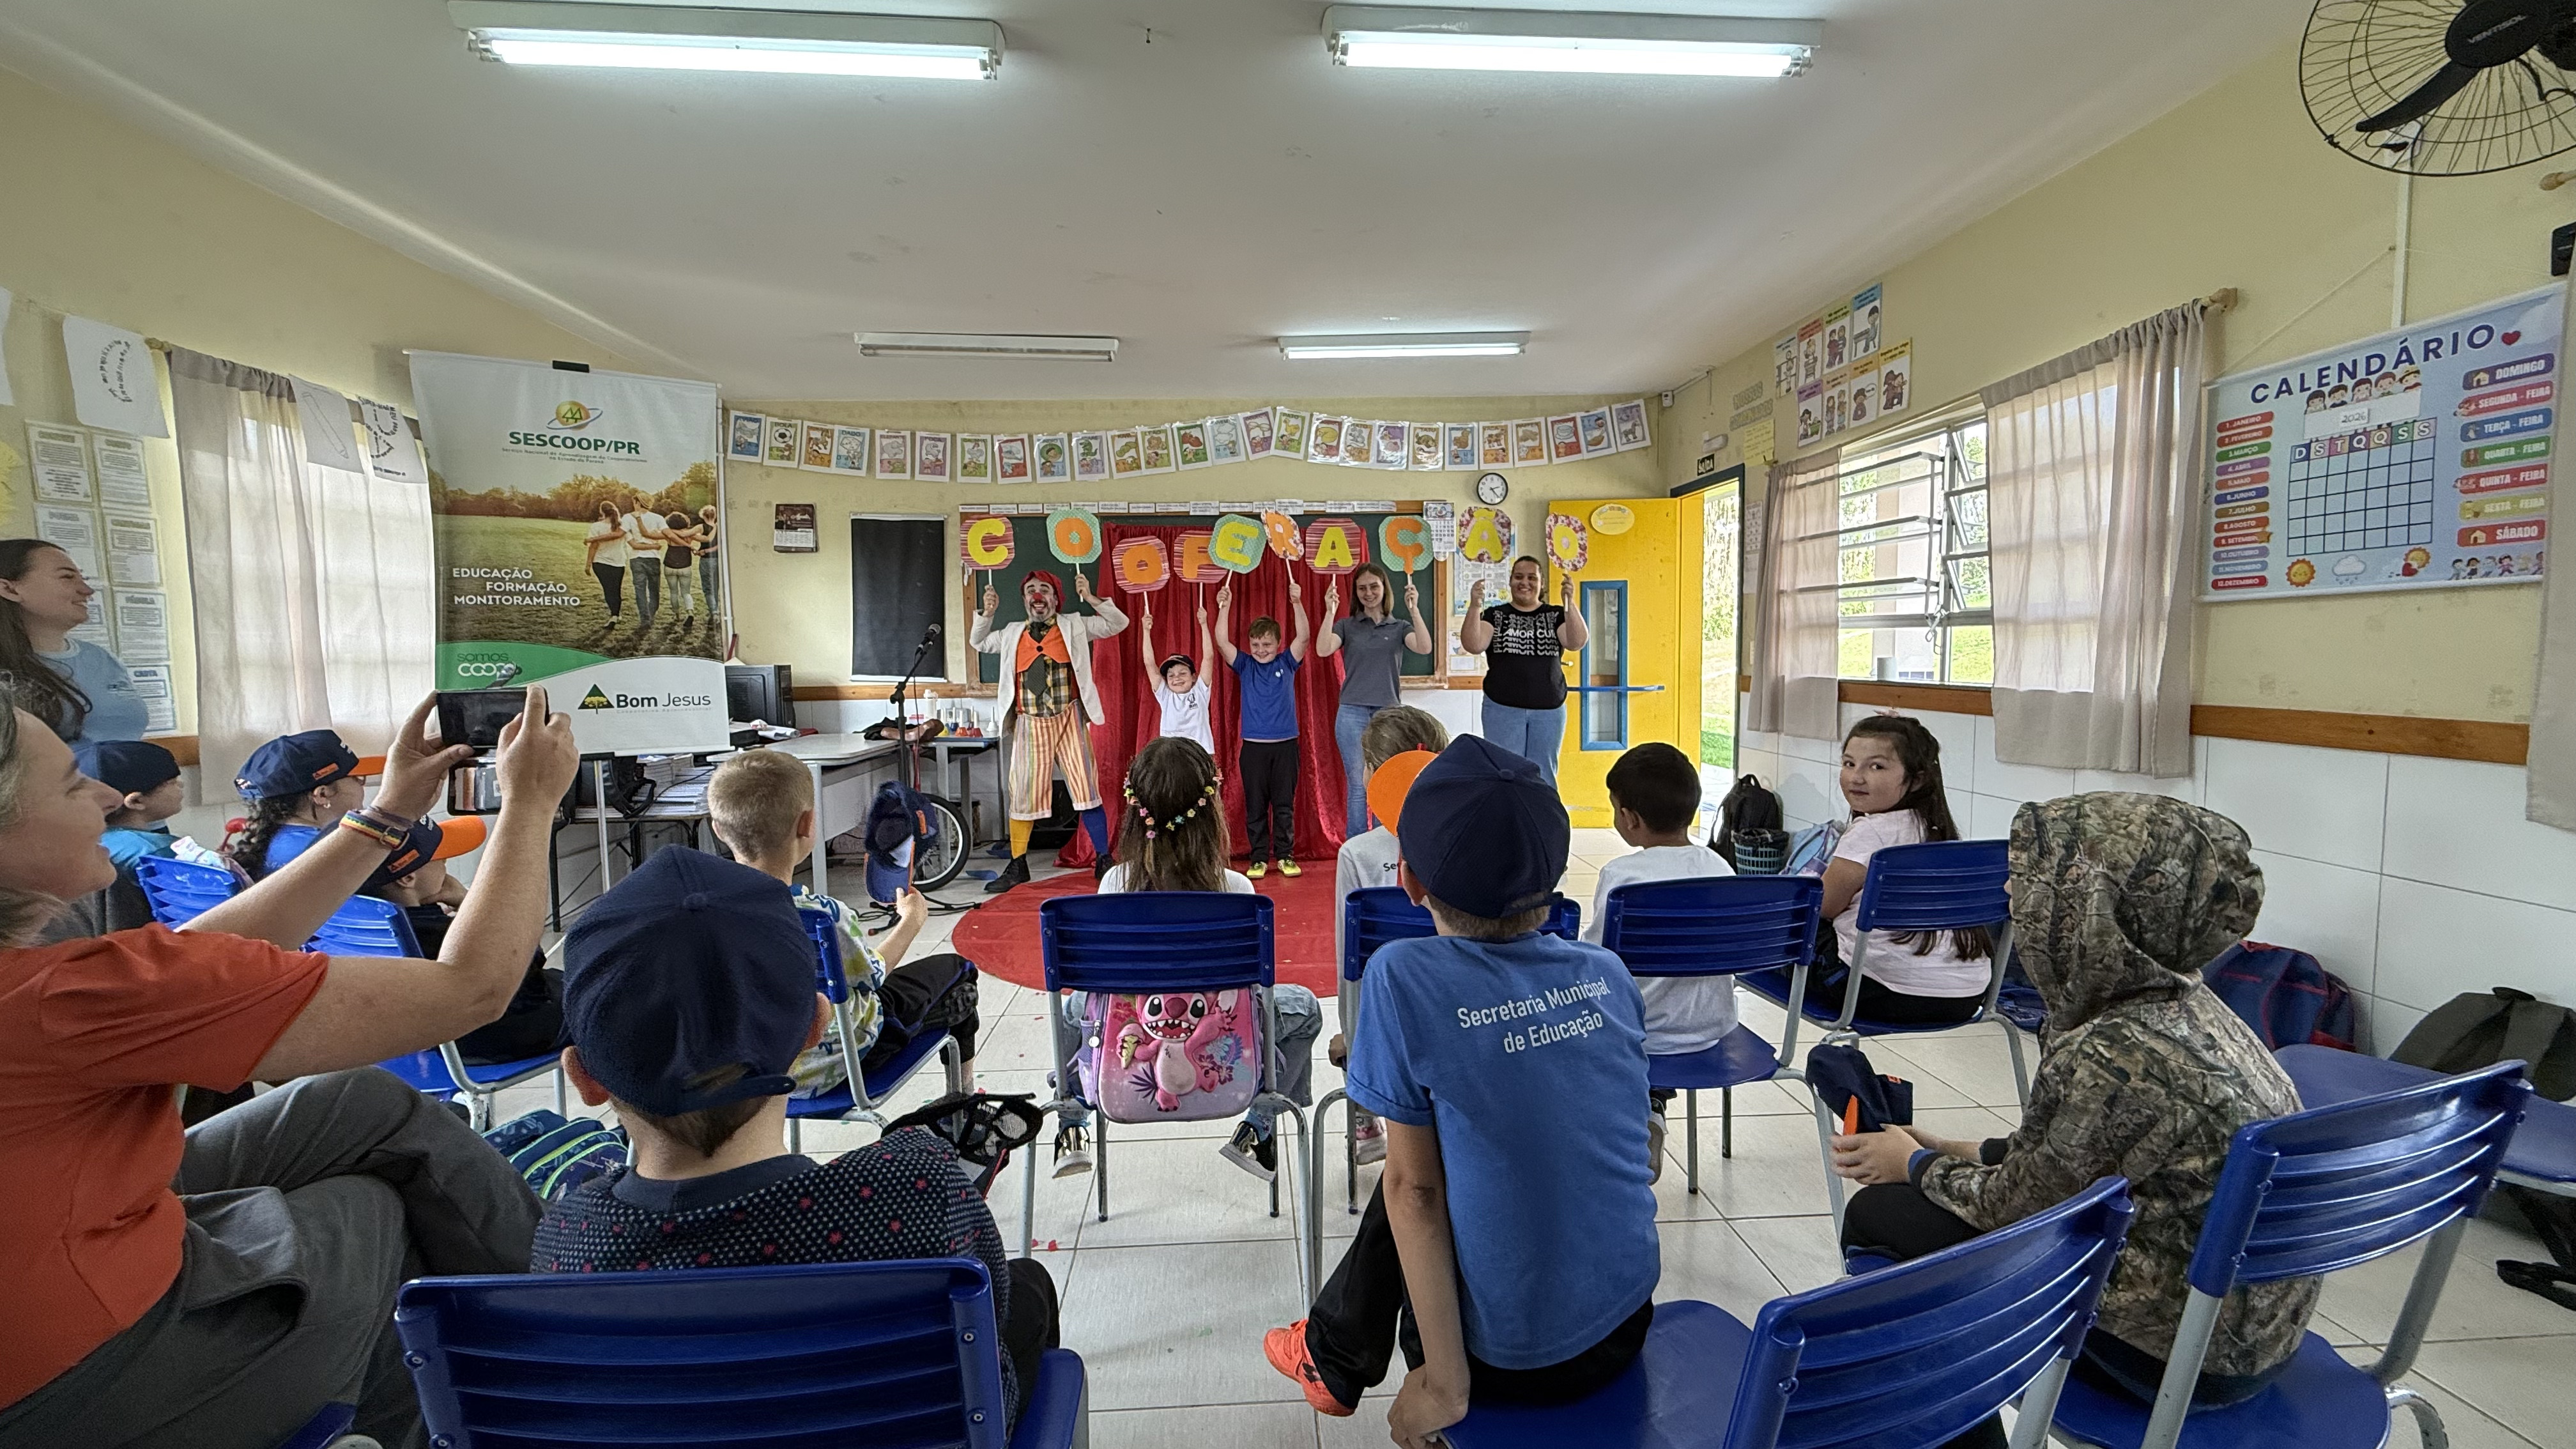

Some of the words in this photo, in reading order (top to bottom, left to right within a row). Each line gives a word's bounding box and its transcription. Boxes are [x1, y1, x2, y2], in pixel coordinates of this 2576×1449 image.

[2251, 324, 2495, 404] CALENDÁRIO
[2496, 360, 2545, 380] DOMINGO
[2478, 393, 2518, 408] SEGUNDA
[2526, 386, 2551, 399] FEIRA
[2484, 420, 2511, 434] TERÇA
[2518, 415, 2543, 427] FEIRA
[509, 431, 640, 454] SESCOOP/PR
[2295, 447, 2306, 459] D
[2315, 443, 2325, 456] S
[2335, 440, 2344, 452] T
[2353, 435, 2366, 449] Q
[2373, 431, 2388, 444] Q
[2398, 427, 2409, 440] S
[2419, 422, 2430, 436] S
[2479, 474, 2511, 487] QUINTA
[2520, 470, 2545, 482] FEIRA
[2228, 535, 2259, 544] SETEMBR
[2496, 525, 2538, 540] SÁBADO
[453, 567, 532, 581] EDUCAÇÃO
[486, 581, 567, 594] FORMAÇÃO
[454, 595, 580, 606] MONITORAMENTO
[1503, 629, 1535, 638] AMOR
[457, 653, 509, 662] somos
[617, 694, 657, 708] Bom
[662, 693, 711, 707] Jesus
[1383, 862, 1399, 871] Se
[1457, 994, 1547, 1029] Secretaria
[1545, 976, 1611, 1009] Municipal
[1503, 1032, 1526, 1054] de
[1530, 1009, 1603, 1048] Educação
